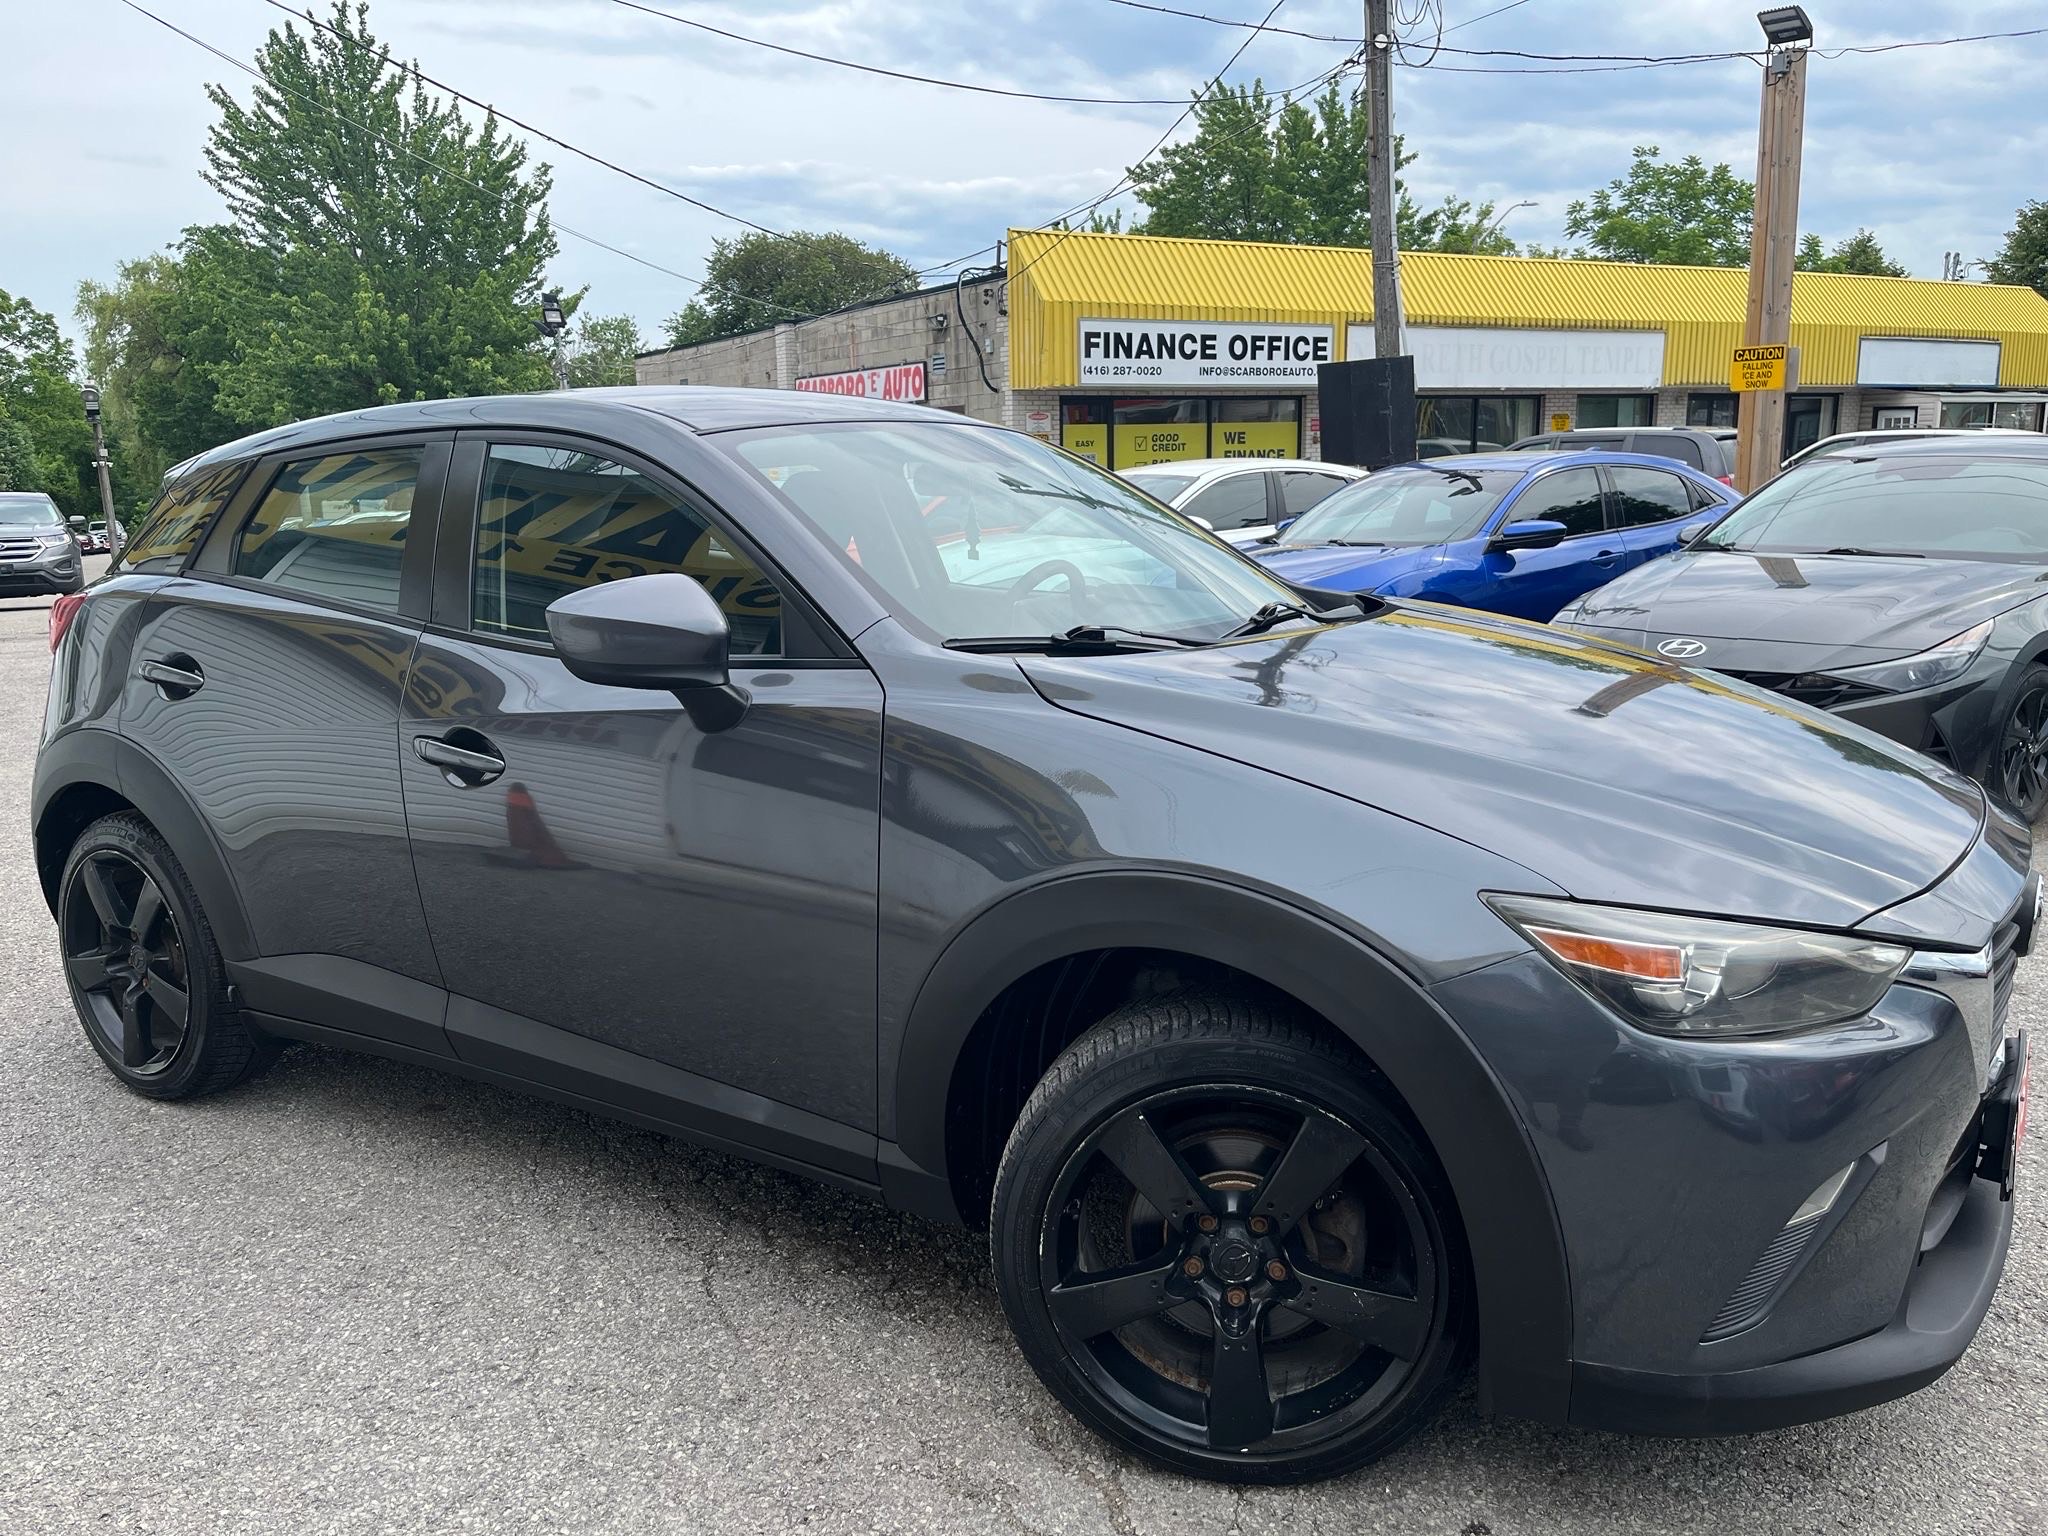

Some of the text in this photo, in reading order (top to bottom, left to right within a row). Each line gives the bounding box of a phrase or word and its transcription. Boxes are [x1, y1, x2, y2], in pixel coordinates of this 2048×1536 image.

[1083, 331, 1329, 362] FINANCE OFFICE
[1488, 342, 1574, 375] GOSPEL
[1577, 343, 1659, 375] TEMPLE
[1735, 347, 1783, 361] CAUTION
[1083, 366, 1319, 378] (416) 287-0020 INFO@SCARBOROEAUTO.
[1742, 362, 1774, 371] FALLING
[1756, 371, 1773, 379] AND
[883, 365, 923, 400] AUTO
[1745, 380, 1769, 389] SNOW
[1151, 433, 1180, 443] GOOD
[1223, 431, 1246, 445] WE
[1075, 440, 1095, 448] EASY
[1151, 443, 1187, 452] CREDIT
[1223, 448, 1286, 459] FINANCE
